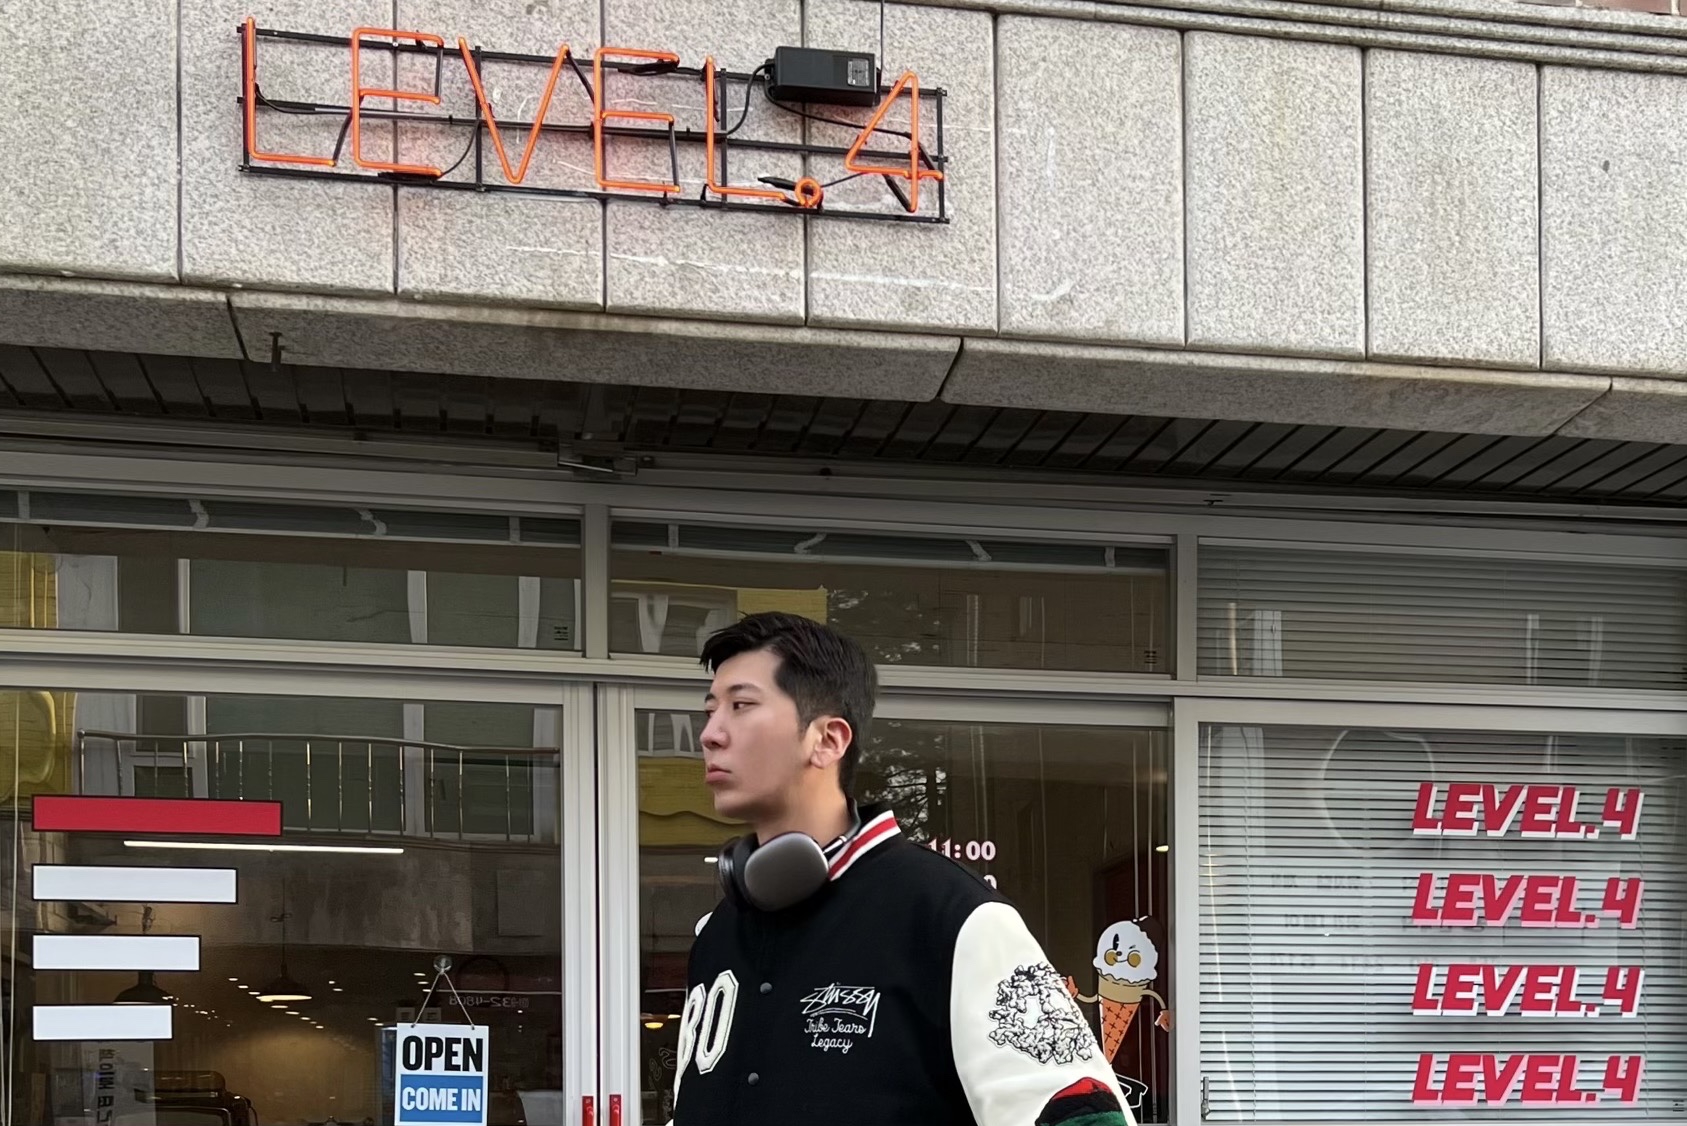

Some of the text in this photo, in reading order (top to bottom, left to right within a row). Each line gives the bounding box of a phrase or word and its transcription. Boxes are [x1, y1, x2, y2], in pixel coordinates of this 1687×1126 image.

[1412, 782, 1644, 840] LEVEL.4
[1411, 872, 1644, 929] LEVEL.4
[1412, 963, 1645, 1018] LEVEL.4
[402, 1035, 484, 1072] OPEN
[811, 1033, 853, 1054] Legacy
[402, 1086, 481, 1112] COME IN
[1411, 1053, 1644, 1104] LEVEL.4
